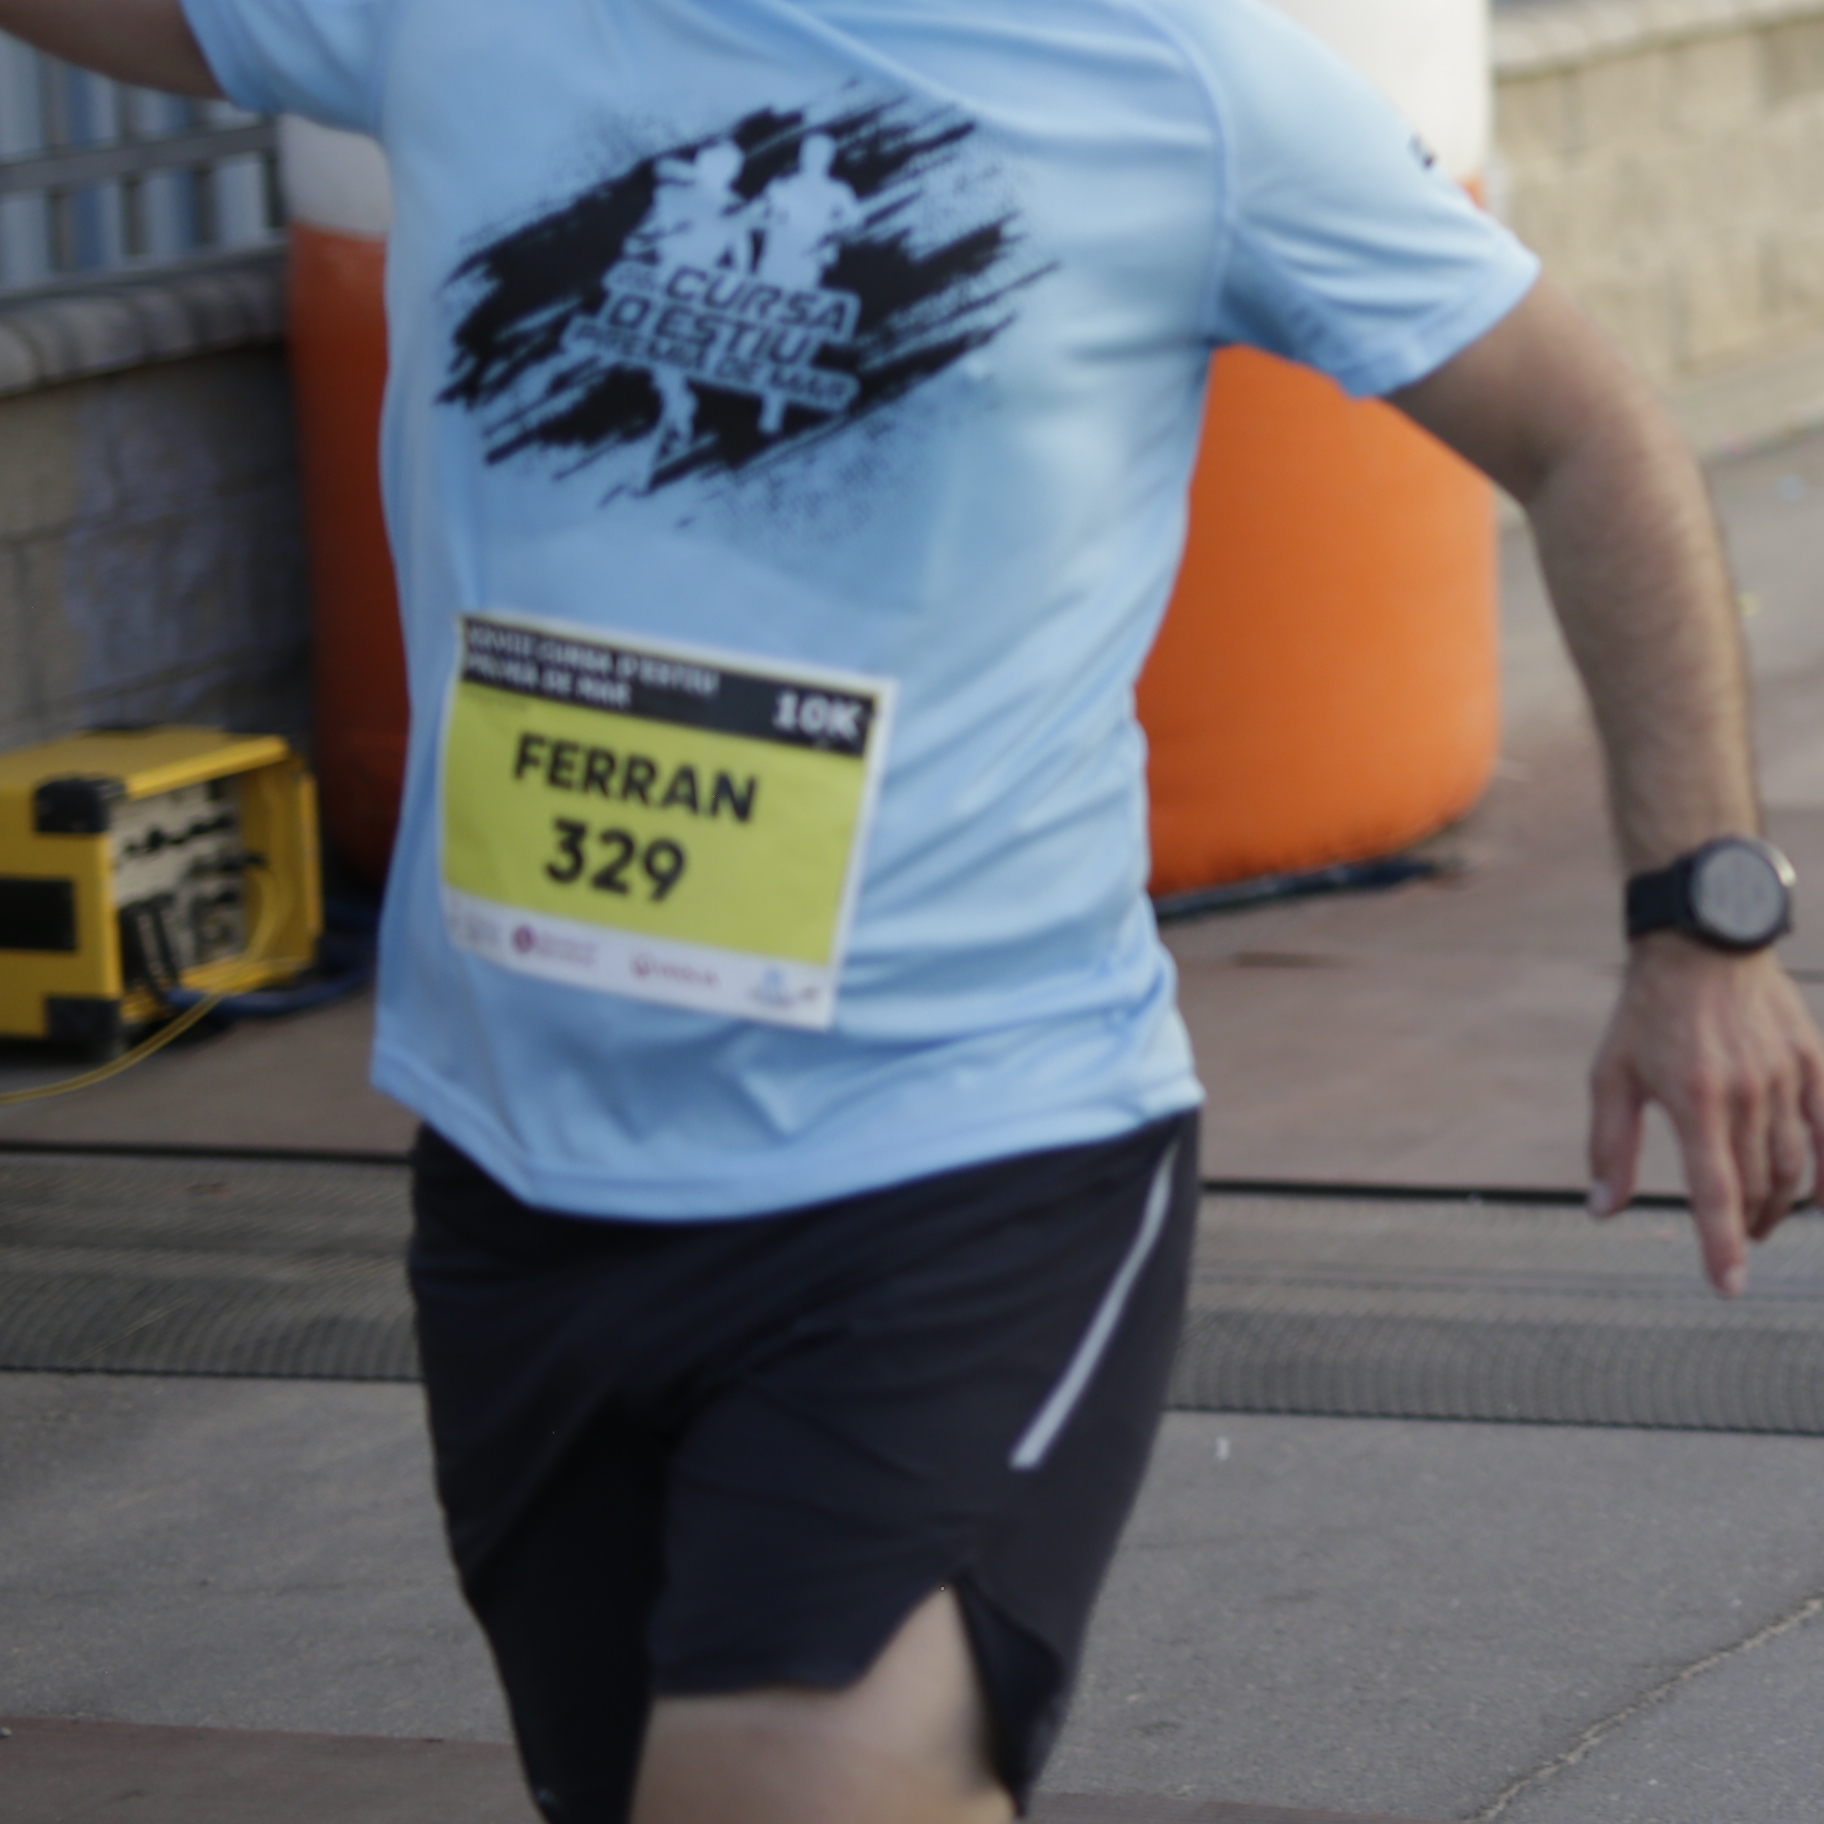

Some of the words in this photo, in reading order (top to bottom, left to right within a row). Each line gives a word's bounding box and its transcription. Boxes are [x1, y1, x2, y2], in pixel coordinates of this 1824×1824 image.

[666, 266, 847, 334] CURSA
[772, 689, 864, 739] 10K
[512, 730, 760, 824] FERRAN
[543, 817, 689, 903] 329
